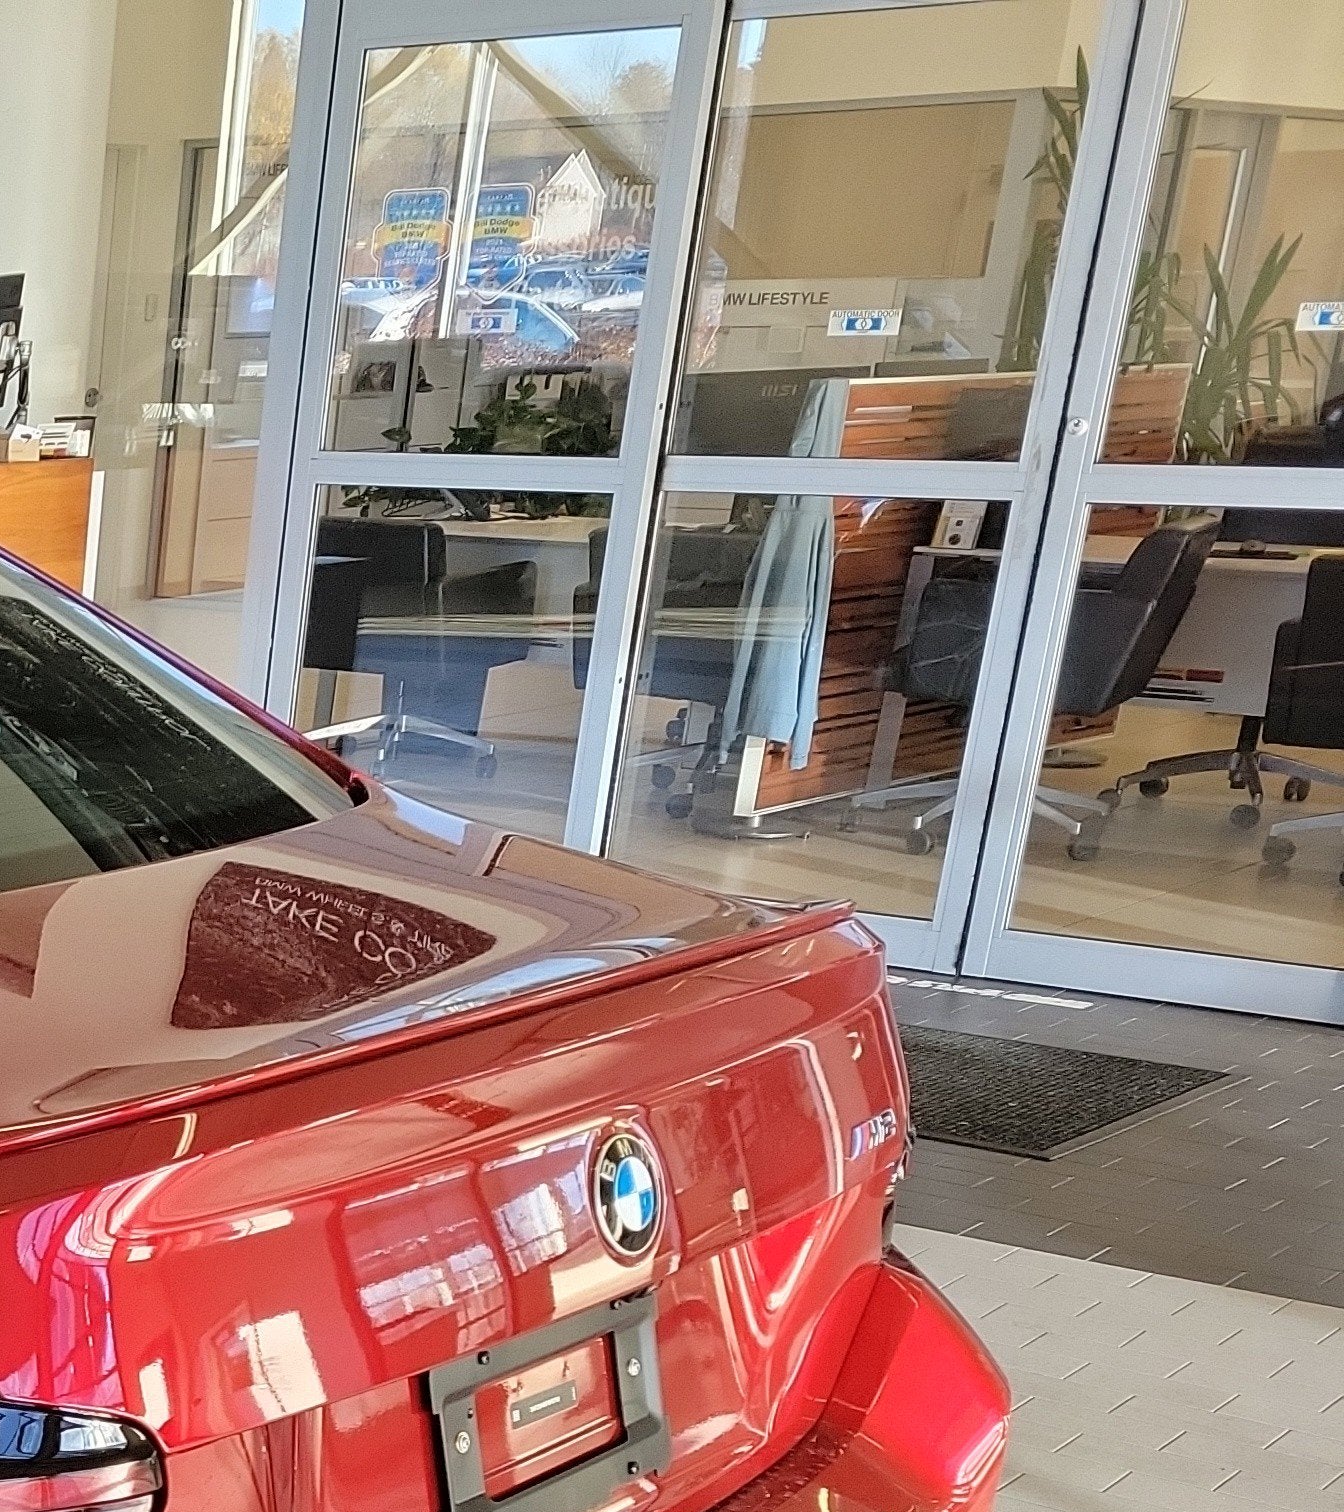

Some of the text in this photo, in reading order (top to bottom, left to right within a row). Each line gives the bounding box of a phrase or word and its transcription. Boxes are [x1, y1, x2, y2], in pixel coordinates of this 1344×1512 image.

[490, 218, 520, 228] Dodge
[484, 227, 508, 235] BMW
[748, 291, 830, 306] LIFESTYLE
[832, 310, 900, 318] AUTOMATIC DOOR
